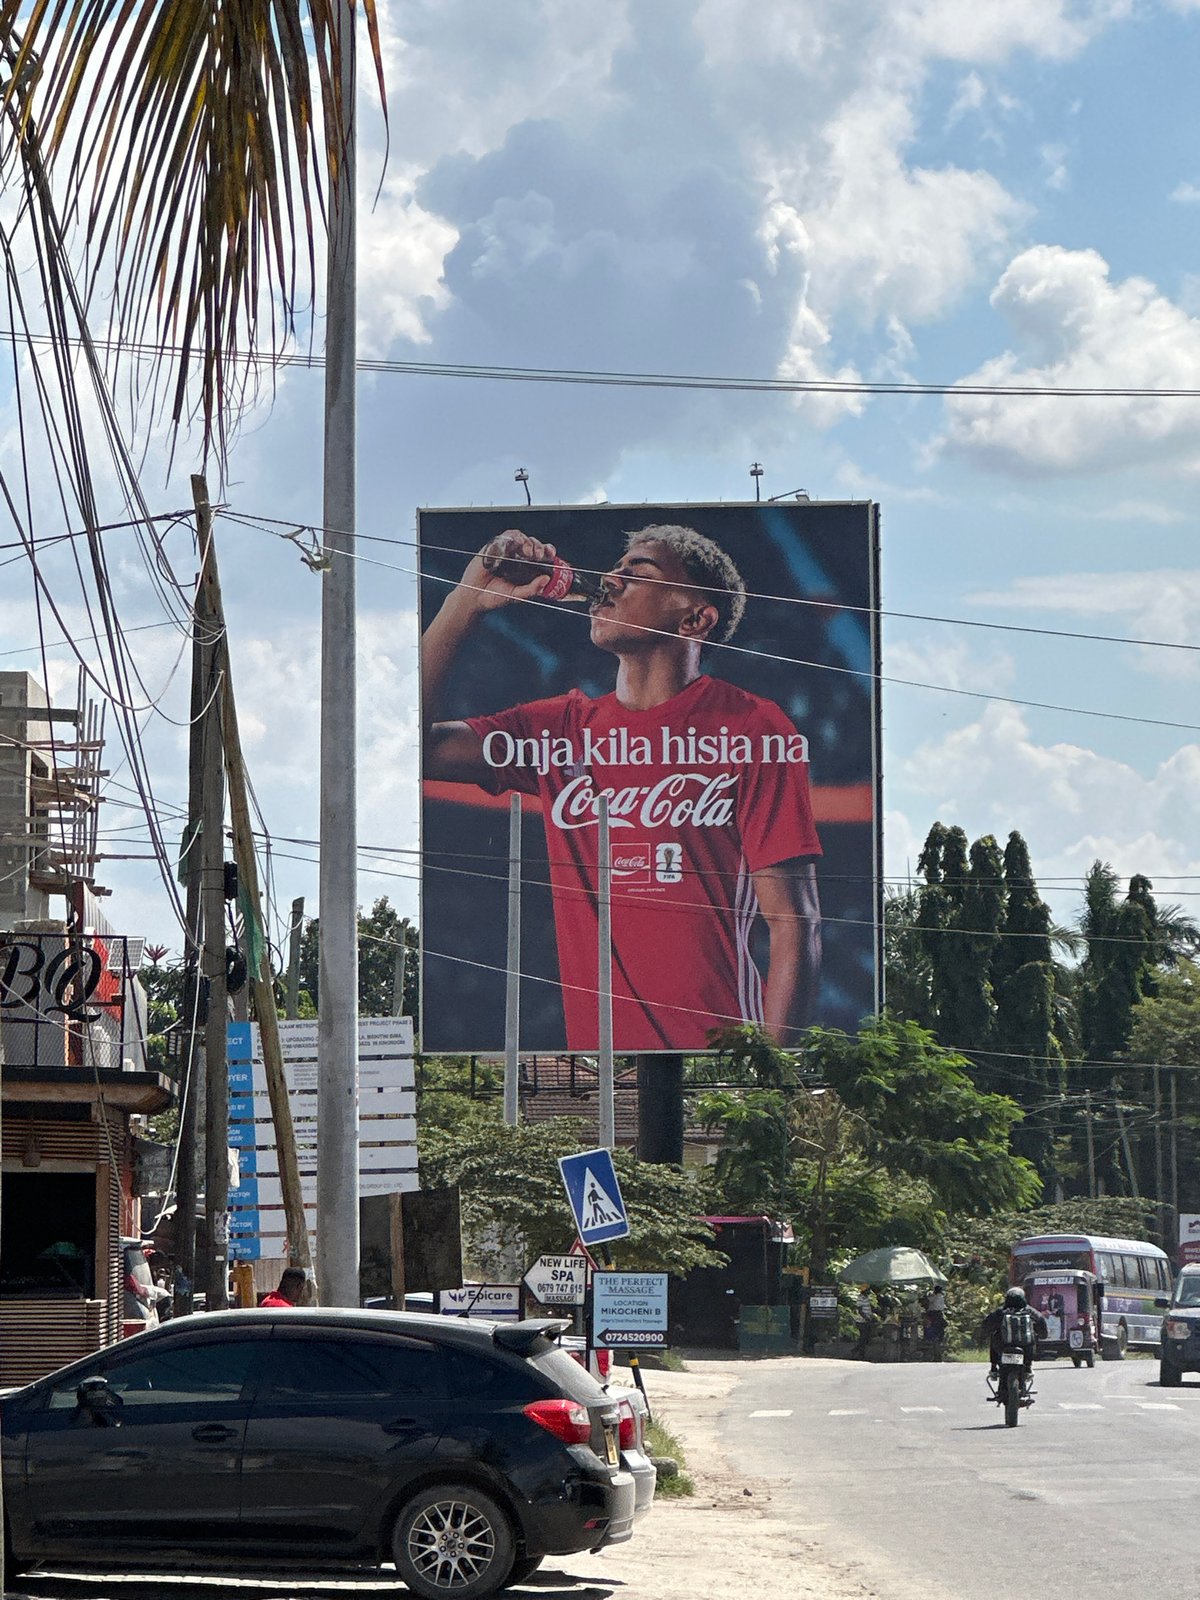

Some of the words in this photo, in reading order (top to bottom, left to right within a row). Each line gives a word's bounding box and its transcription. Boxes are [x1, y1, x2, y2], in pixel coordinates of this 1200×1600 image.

[482, 729, 574, 775] Onja
[582, 727, 653, 766] kila
[661, 726, 753, 765] hisia
[761, 733, 810, 764] na
[551, 773, 740, 829] Coca-Cola
[540, 1258, 562, 1268] NEW
[564, 1259, 585, 1269] LIFE
[551, 1269, 575, 1282] SPA
[599, 1277, 619, 1286] THE
[621, 1277, 664, 1286] PERFECT
[537, 1282, 554, 1293] 0679
[556, 1283, 568, 1293] 747
[608, 1286, 655, 1295] MASSAGE
[468, 1290, 513, 1303] Epicare
[546, 1295, 575, 1303] MASSAGE
[601, 1308, 653, 1316] MIKOCHENI
[605, 1333, 665, 1342] 0724520900
